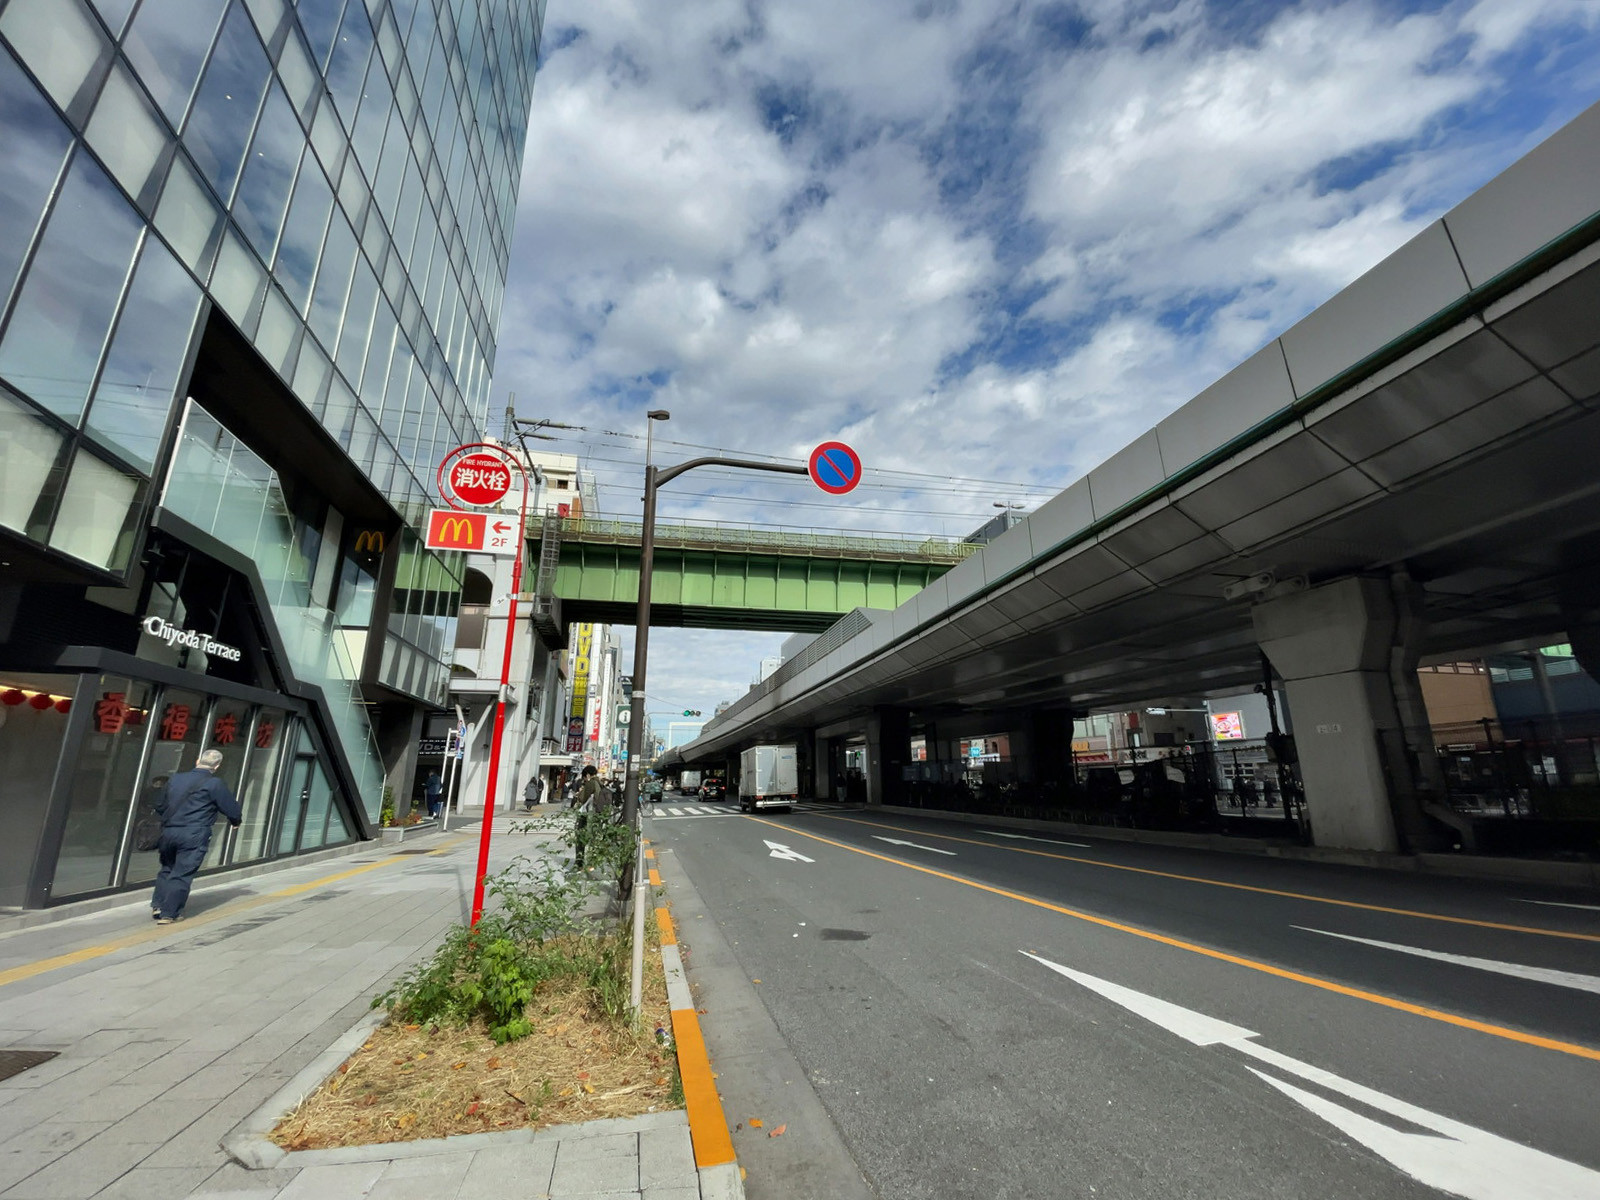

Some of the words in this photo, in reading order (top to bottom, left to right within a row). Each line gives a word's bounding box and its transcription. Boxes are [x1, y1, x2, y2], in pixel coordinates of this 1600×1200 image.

[462, 458, 476, 466] FIRE
[476, 460, 503, 468] HYDRANT
[455, 467, 507, 491] 消火栓
[491, 537, 508, 547] 2F
[145, 616, 199, 647] Chiyoda
[200, 633, 241, 662] Terrace
